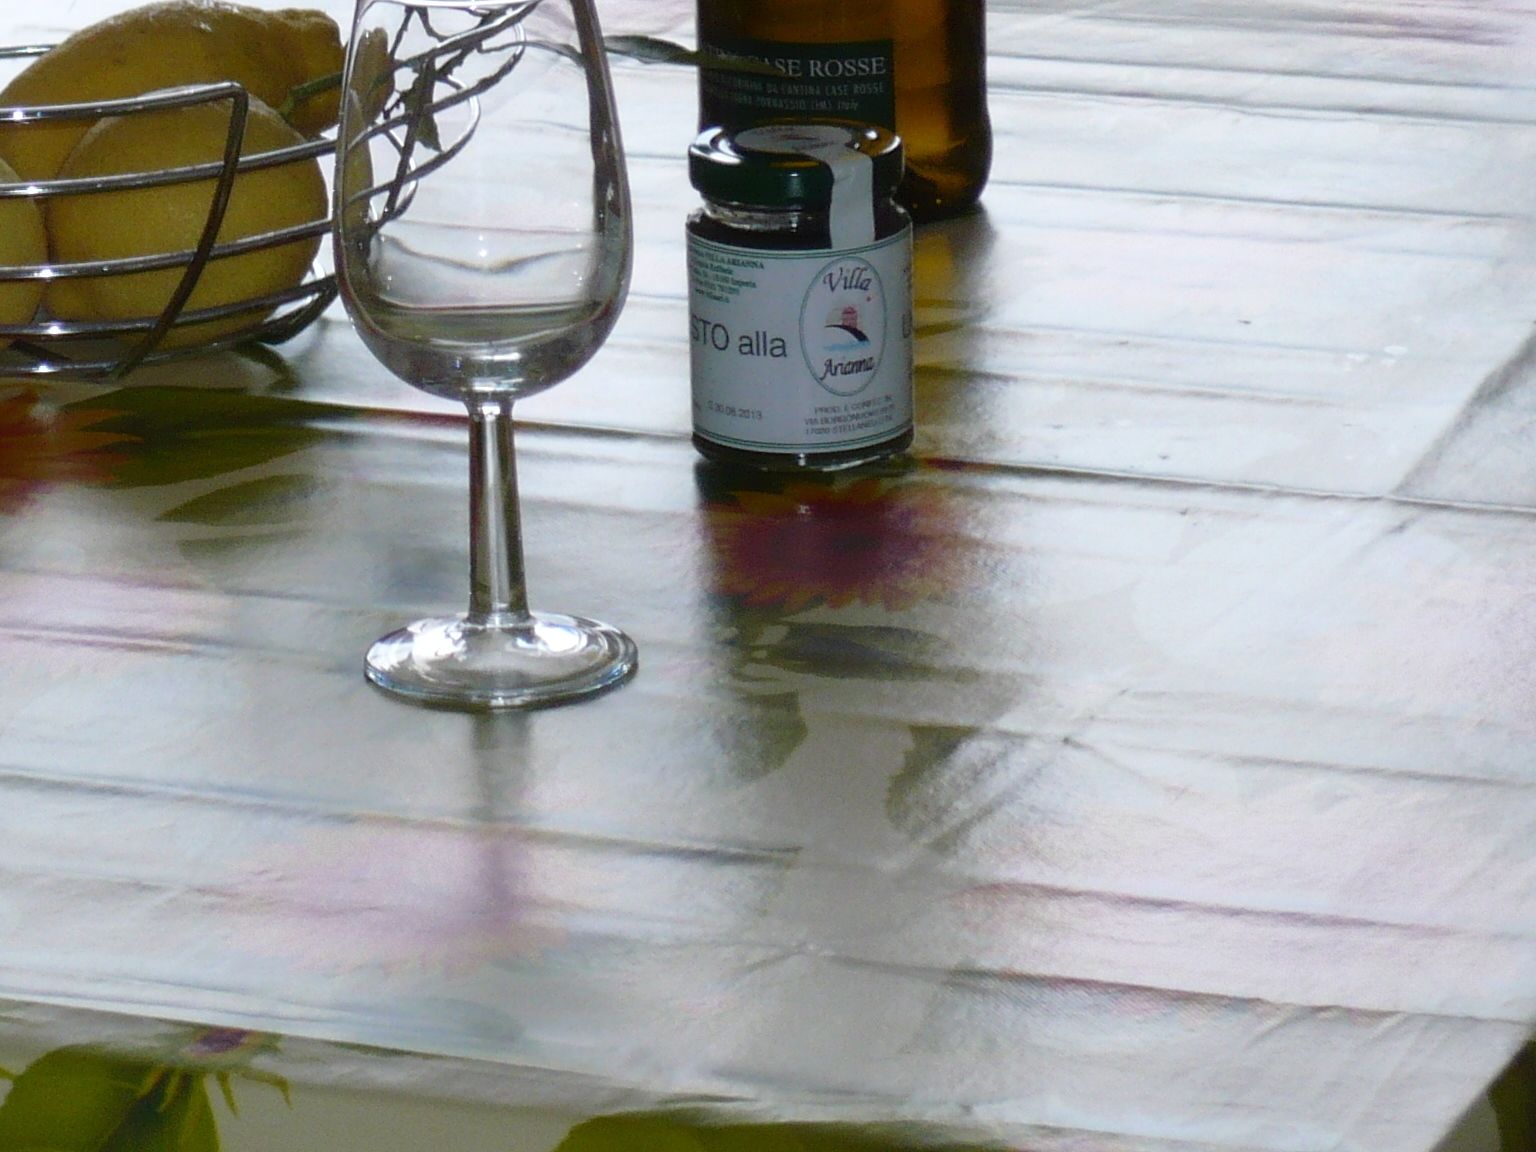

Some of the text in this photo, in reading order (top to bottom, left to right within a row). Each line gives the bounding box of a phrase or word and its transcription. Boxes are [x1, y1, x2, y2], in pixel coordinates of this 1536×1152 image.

[808, 56, 887, 77] ROSSE
[822, 267, 872, 292] Villa
[691, 314, 787, 358] STO alla
[820, 356, 875, 381] Arianna
